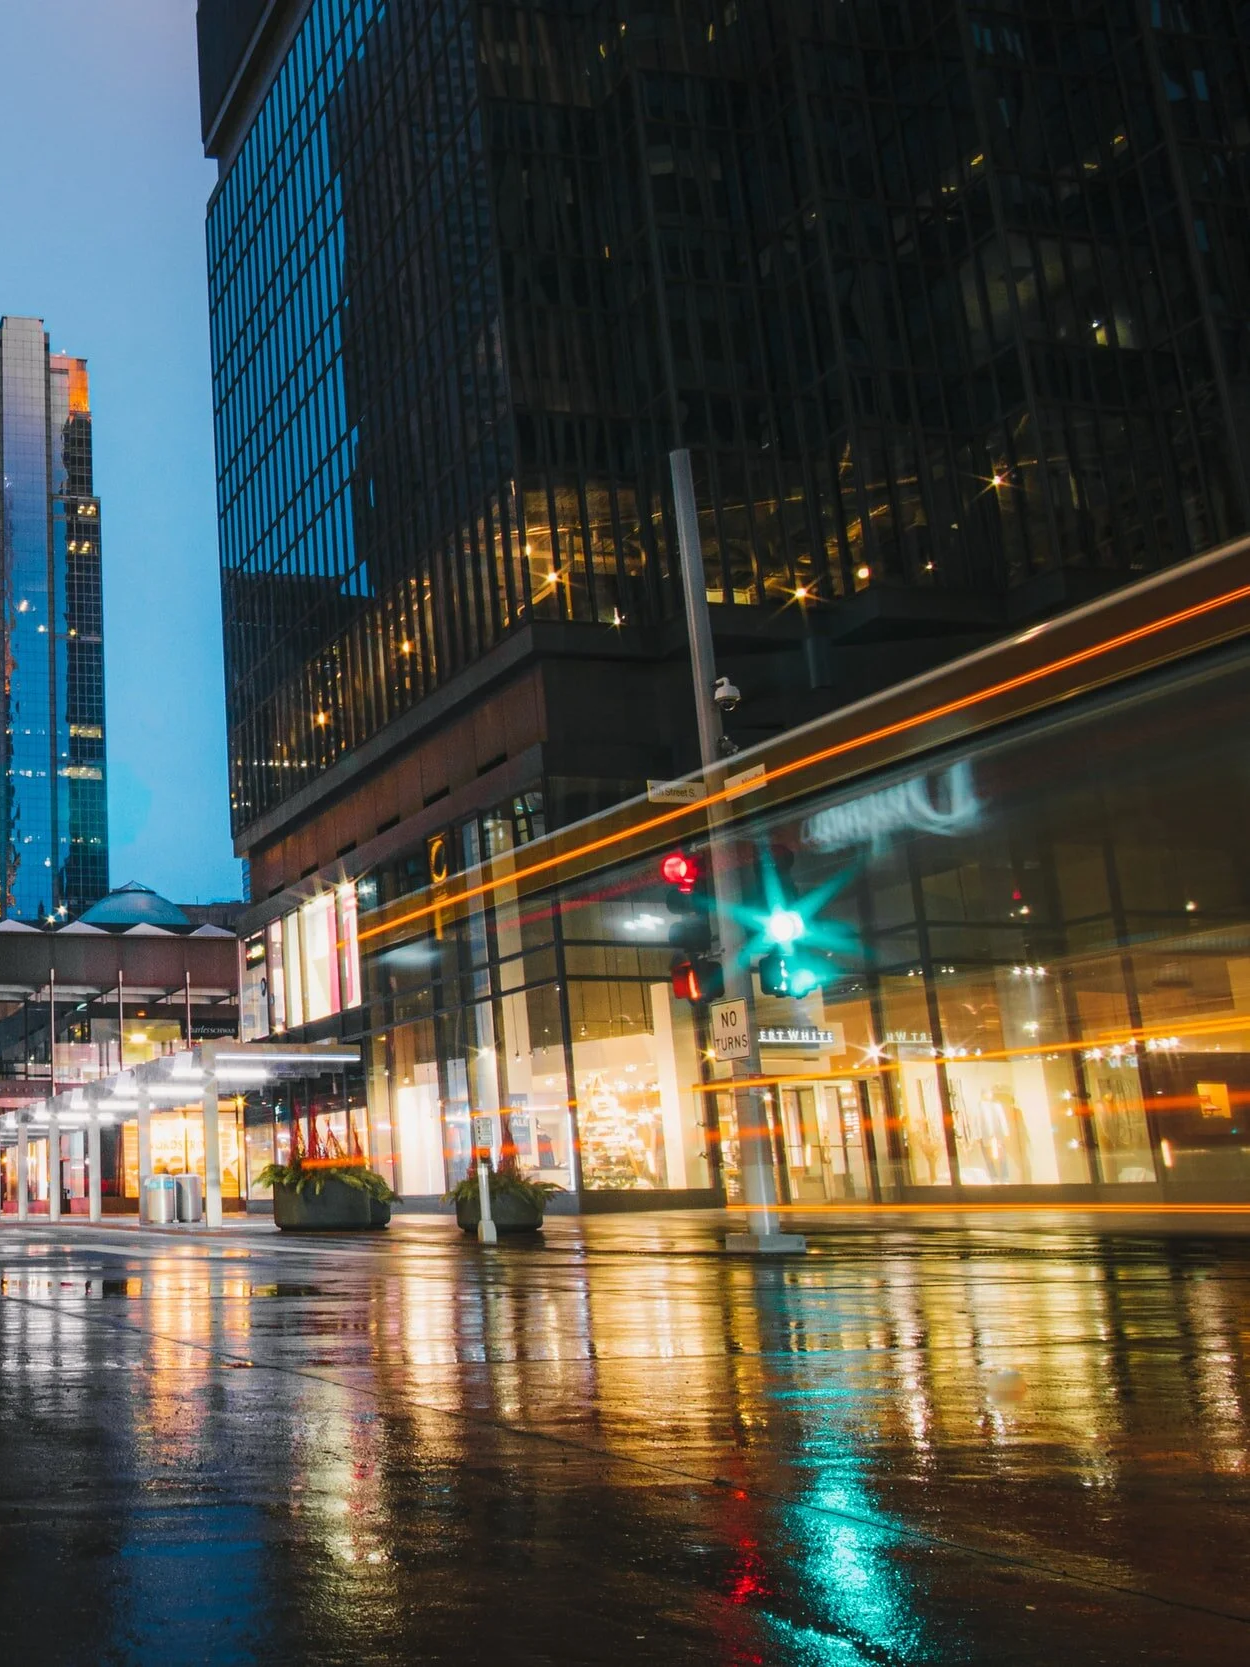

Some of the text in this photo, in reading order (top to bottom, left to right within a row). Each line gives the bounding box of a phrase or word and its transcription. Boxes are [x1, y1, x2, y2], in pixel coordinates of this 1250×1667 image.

[665, 787, 688, 797] Street
[720, 1010, 737, 1029] NO
[759, 1029, 833, 1041] ERT WHITE
[715, 1034, 748, 1052] TURNS
